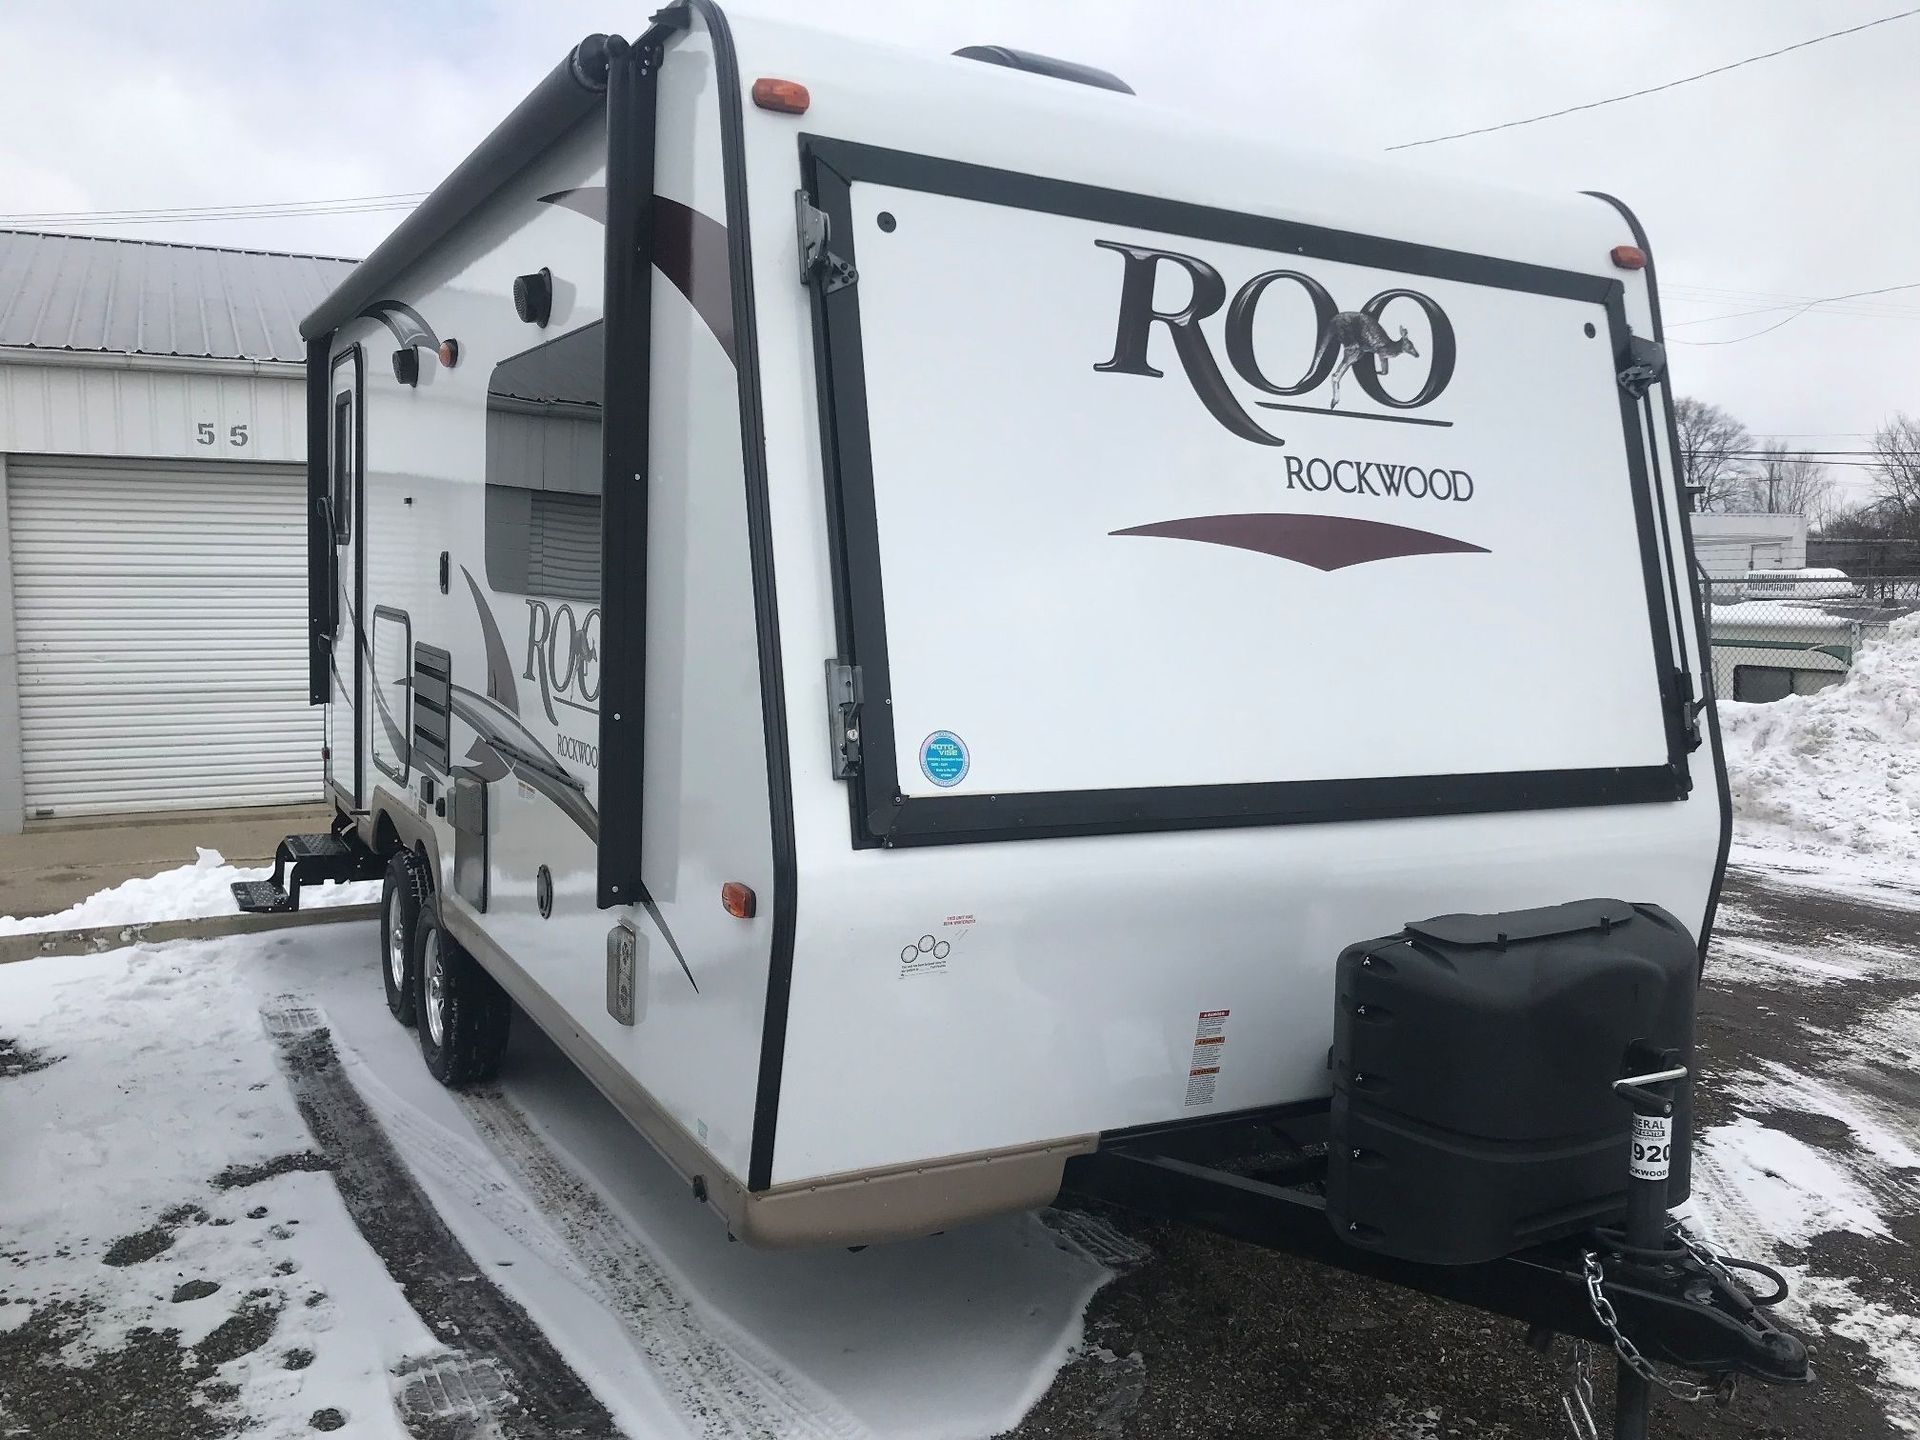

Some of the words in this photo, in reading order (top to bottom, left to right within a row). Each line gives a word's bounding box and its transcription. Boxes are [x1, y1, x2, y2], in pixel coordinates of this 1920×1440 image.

[1093, 239, 1457, 447] ROO
[1283, 455, 1475, 503] ROCKWOOD
[557, 733, 599, 770] ROCKWOO
